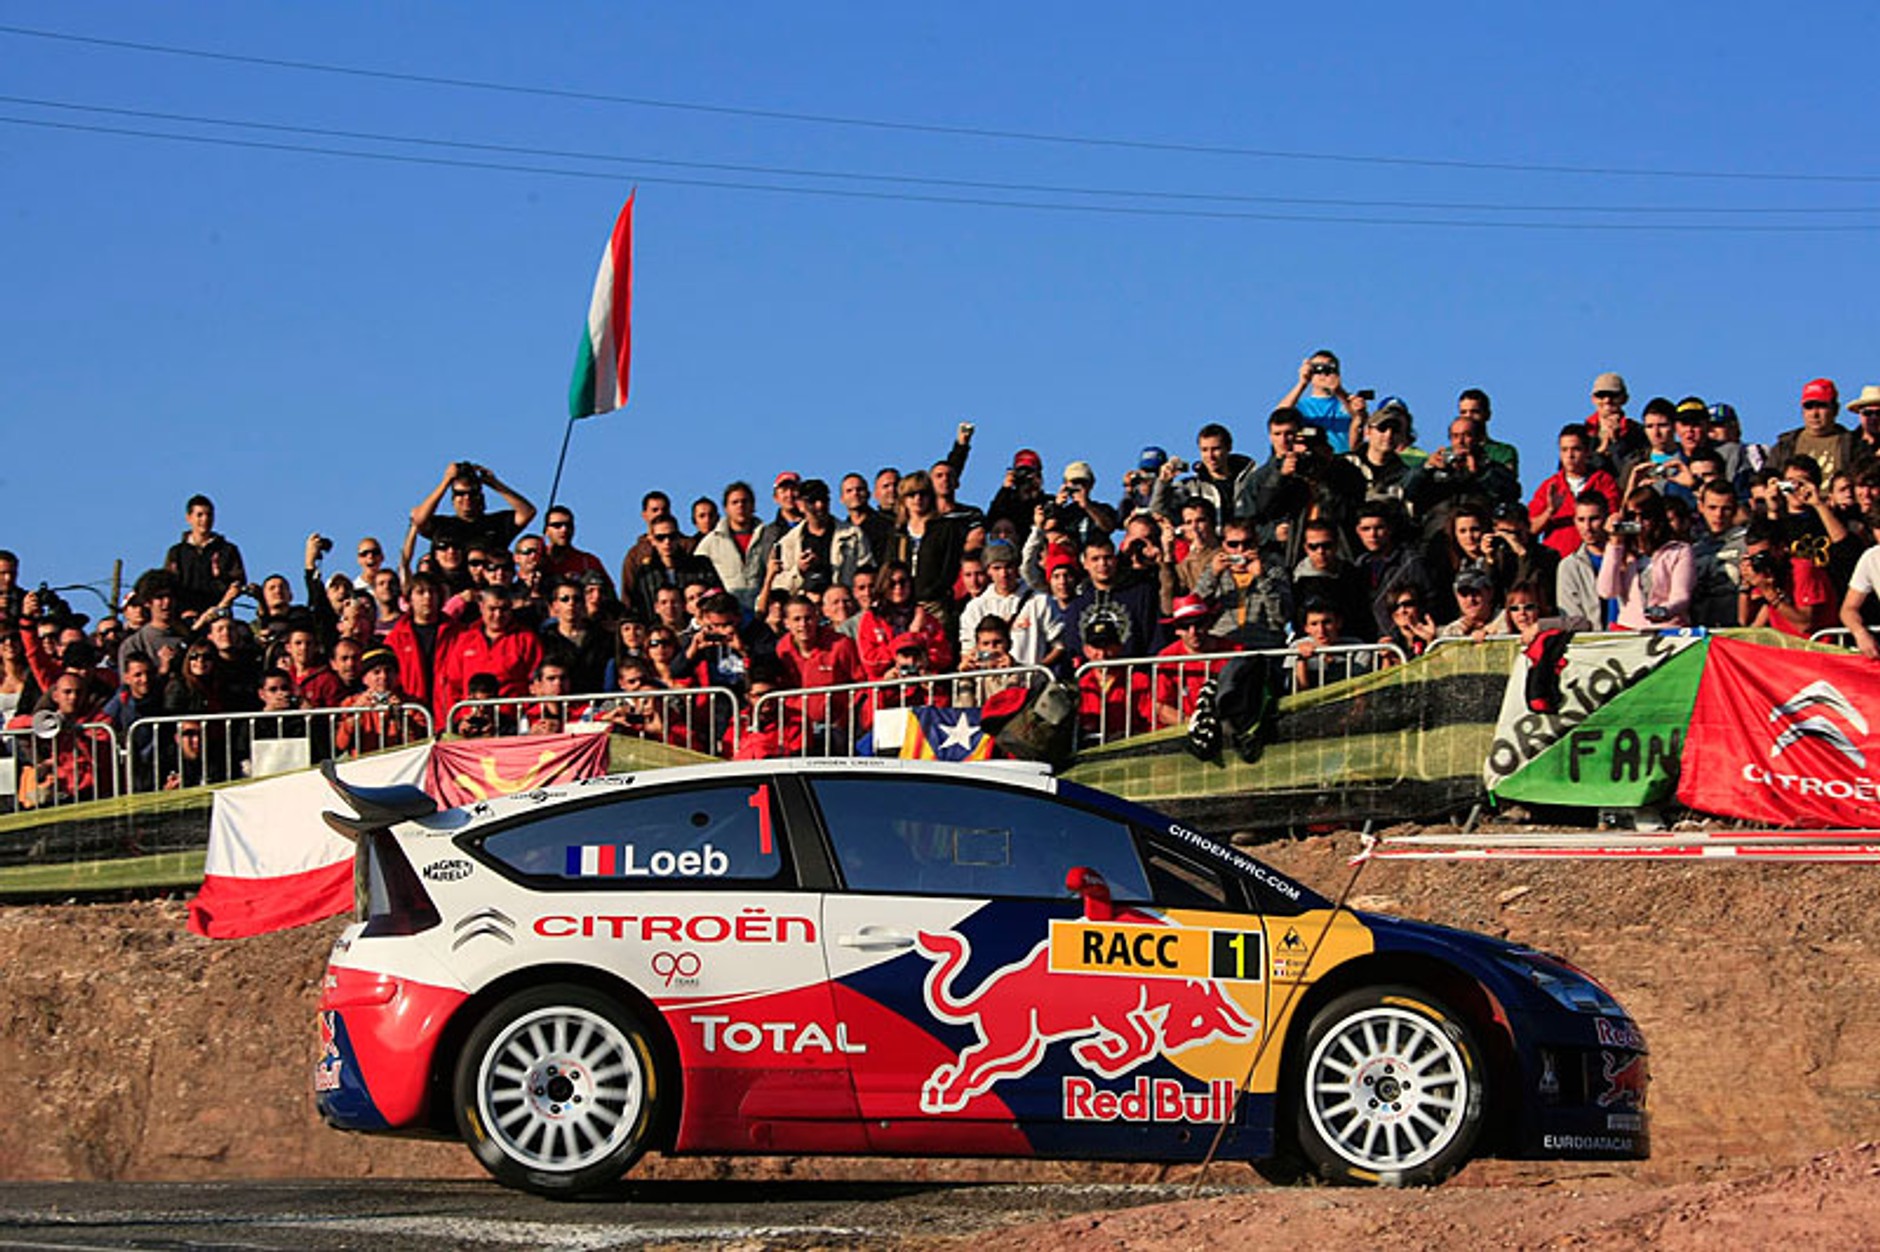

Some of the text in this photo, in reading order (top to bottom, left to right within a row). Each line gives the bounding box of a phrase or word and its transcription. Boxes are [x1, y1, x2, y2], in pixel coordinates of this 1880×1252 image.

[1570, 728, 1680, 783] FAN
[1743, 763, 1880, 801] CITROË
[749, 784, 772, 854] 1
[624, 844, 728, 876] Loeb
[1169, 824, 1300, 900] CITROEN-WRC.COM
[533, 908, 816, 943] CITROËN
[651, 951, 702, 988] 90
[1083, 930, 1245, 978] RACC 1
[691, 1015, 867, 1053] TOTAL
[1063, 1076, 1235, 1124] Red Bull
